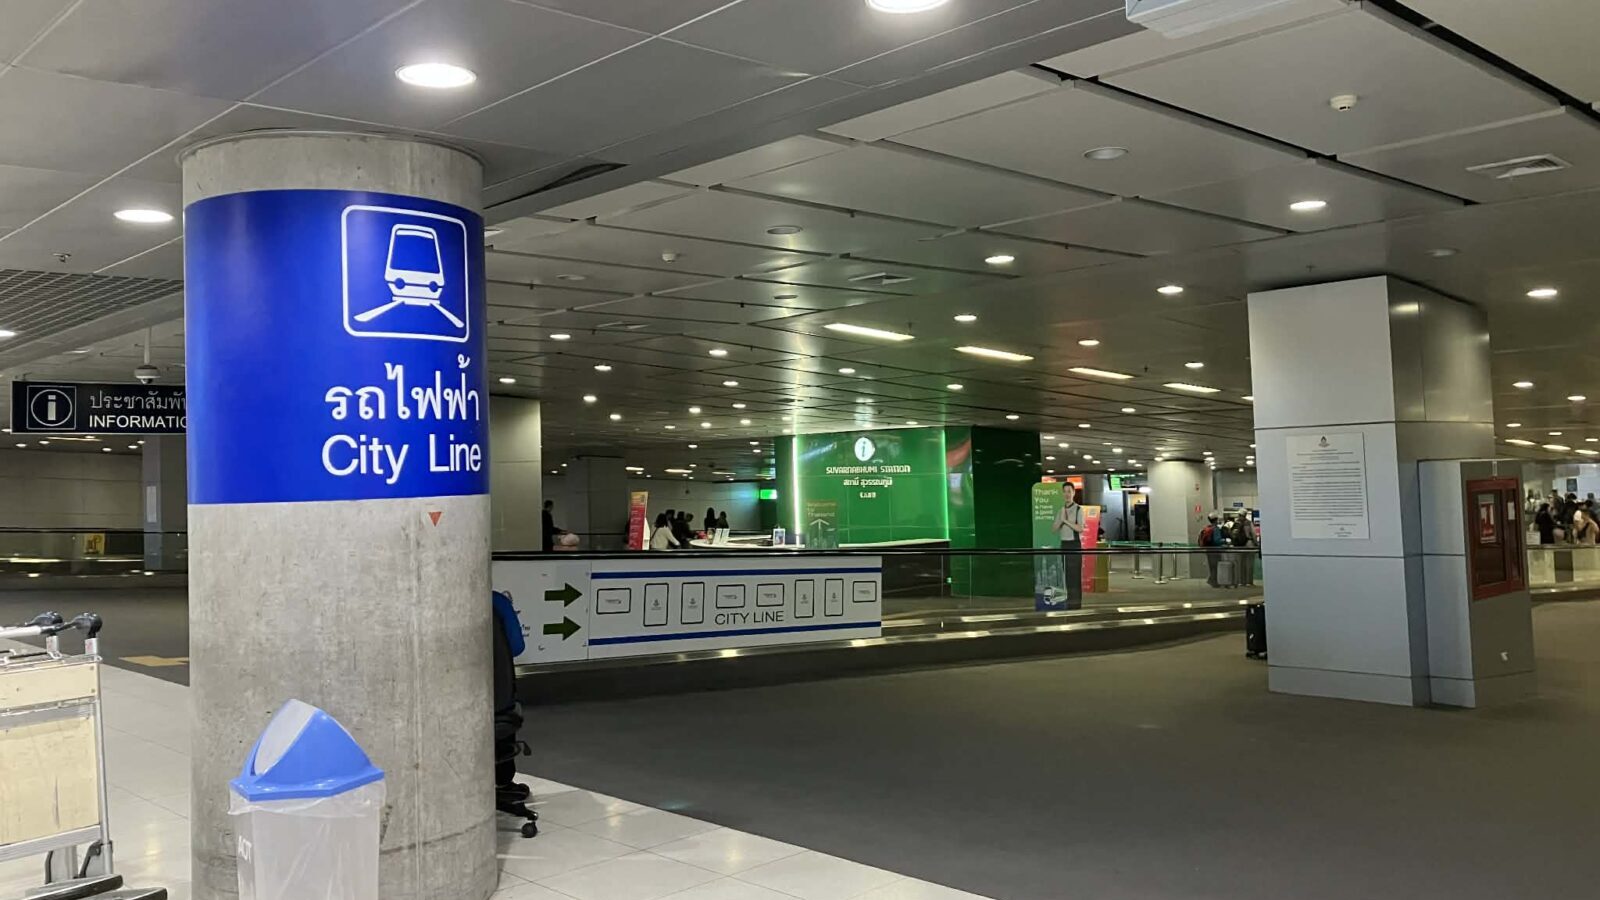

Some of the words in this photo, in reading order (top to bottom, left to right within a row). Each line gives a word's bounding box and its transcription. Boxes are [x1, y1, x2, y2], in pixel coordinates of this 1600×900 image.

[324, 353, 480, 421] รถไฟฟ้า
[321, 434, 409, 485] City
[429, 433, 482, 473] Line
[714, 612, 750, 626] CITY
[753, 611, 785, 623] LINE
